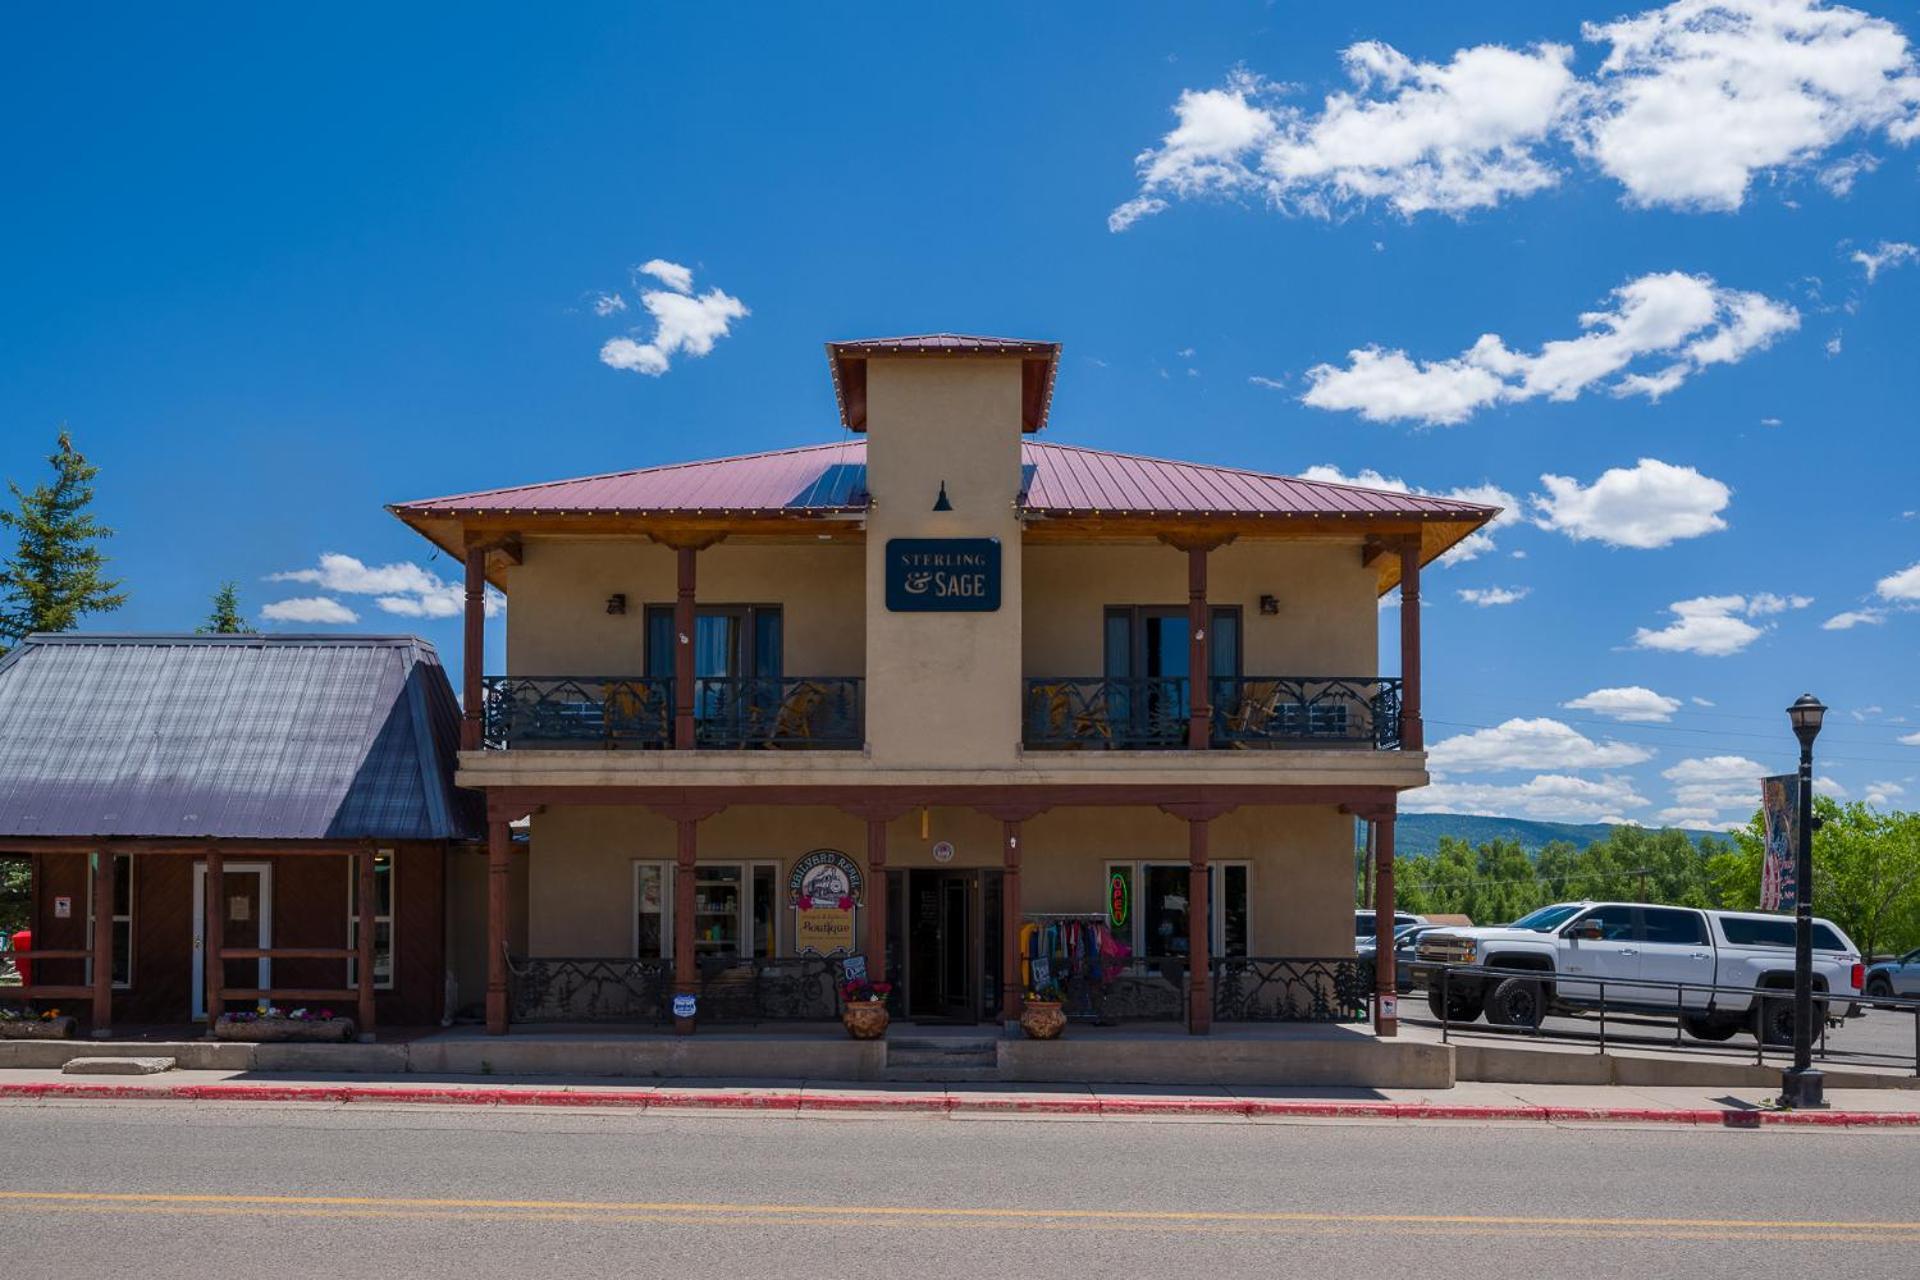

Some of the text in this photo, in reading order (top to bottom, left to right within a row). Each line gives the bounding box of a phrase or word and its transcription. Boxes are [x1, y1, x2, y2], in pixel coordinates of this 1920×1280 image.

[901, 553, 986, 567] STERLING
[904, 571, 985, 597] & SAGE
[790, 853, 836, 889] RAILYARD
[1113, 878, 1123, 921] OPEN
[802, 919, 850, 935] Boutique
